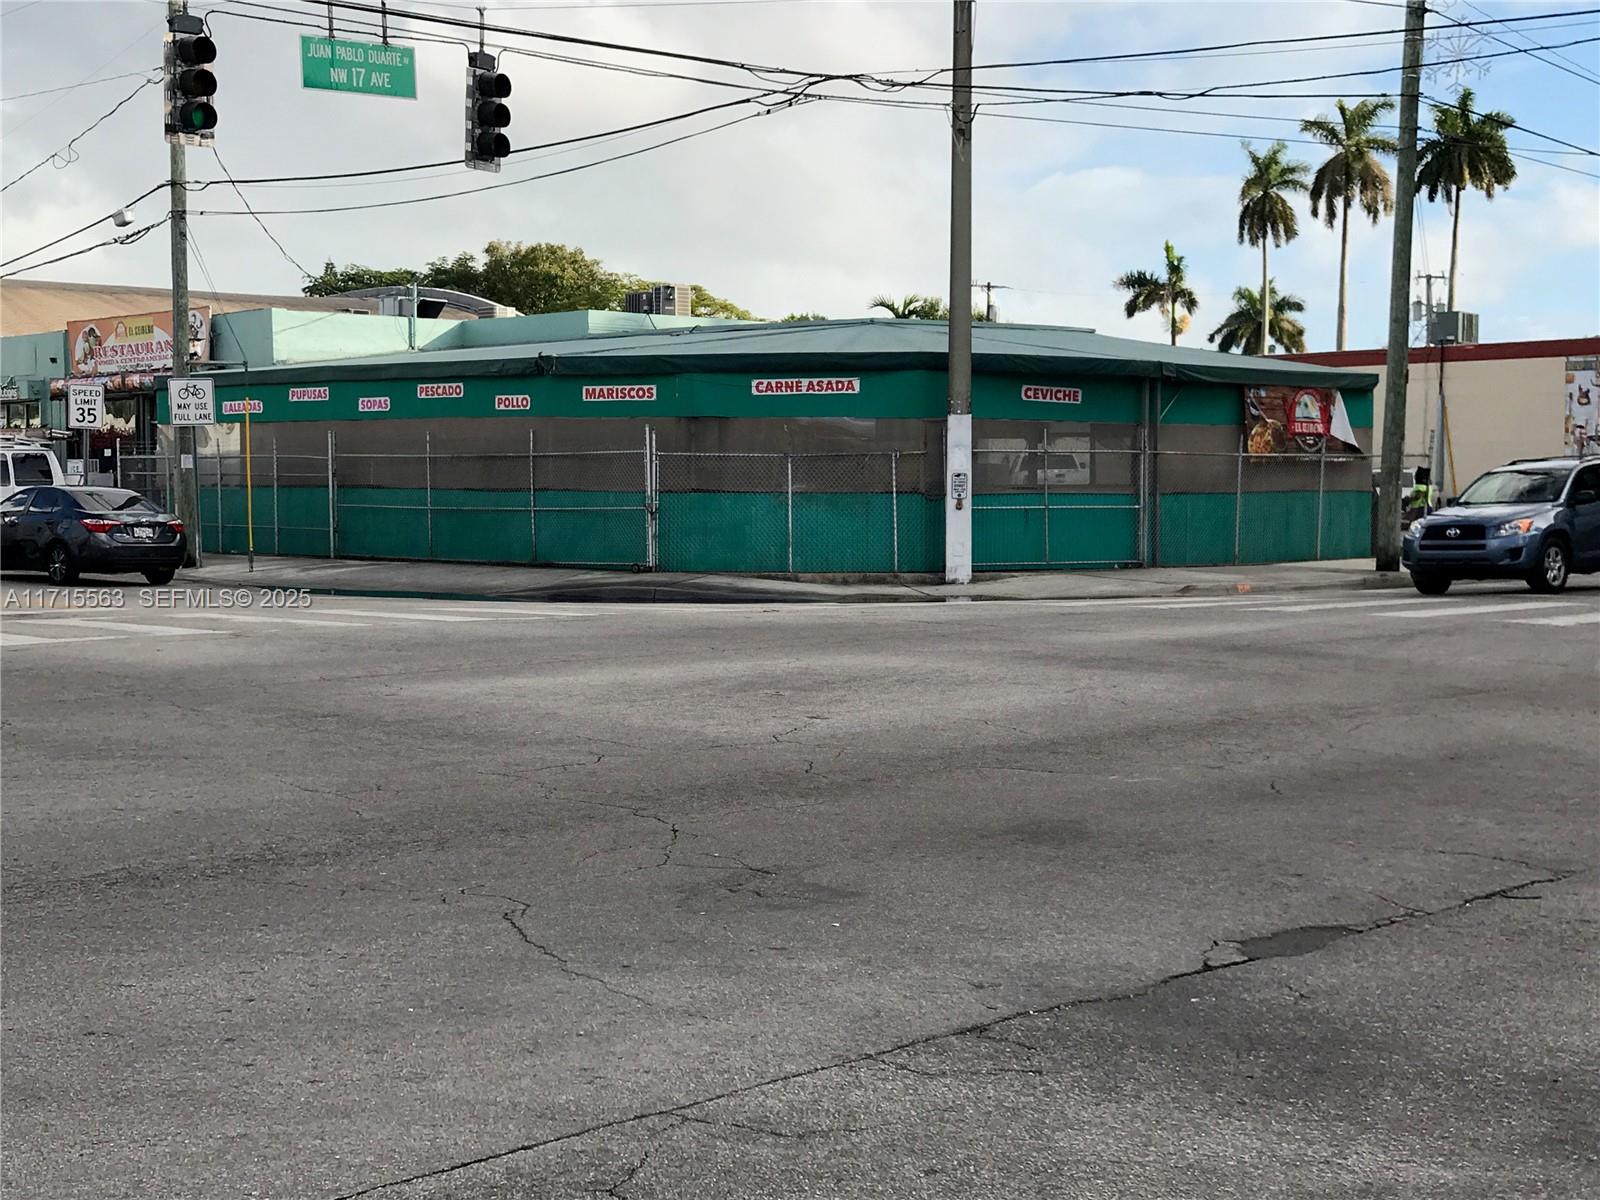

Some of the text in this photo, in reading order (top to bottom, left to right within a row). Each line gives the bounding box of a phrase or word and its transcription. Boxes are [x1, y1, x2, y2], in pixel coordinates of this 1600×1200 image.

[307, 43, 332, 58] JUAN
[336, 46, 364, 62] PABLO
[368, 50, 402, 66] DUARTE
[330, 68, 391, 88] NW 17 AVE
[93, 339, 174, 359] RESTAURAN
[120, 354, 173, 364] CENTROAMERIC
[419, 385, 462, 397] PESCADO
[755, 380, 856, 393] CARNE ASADA
[72, 389, 101, 397] SPEED
[291, 389, 328, 400] PUPUSAS
[585, 387, 654, 400] MARISCOS
[1024, 387, 1079, 402] CEVICHE
[360, 399, 389, 410] SOPAS
[497, 397, 529, 408] POLLO
[75, 407, 97, 424] 35
[174, 413, 212, 421] FULL LANE
